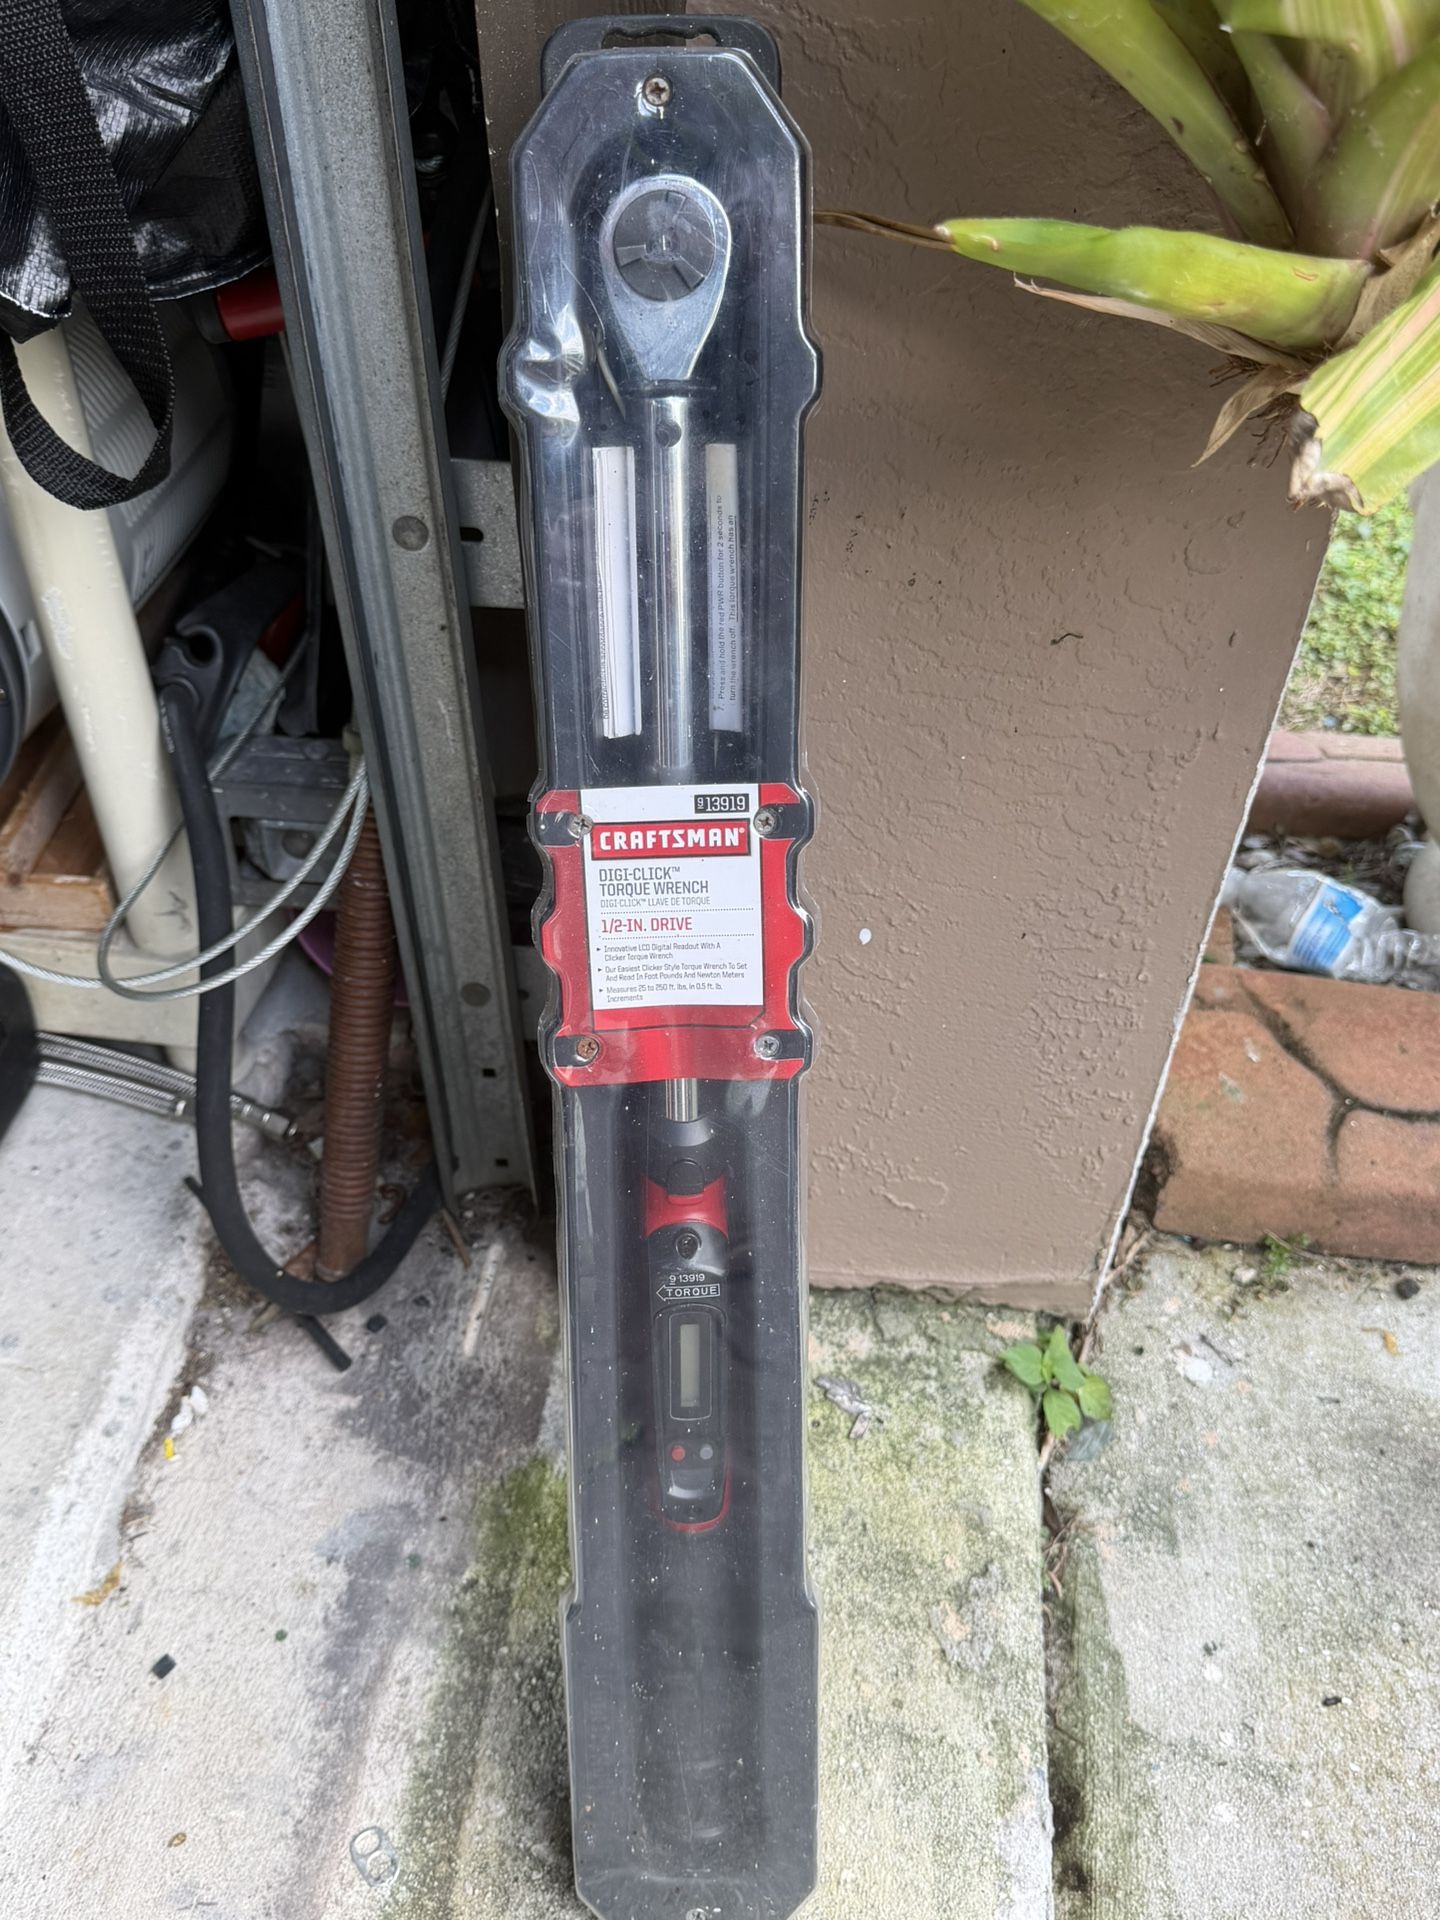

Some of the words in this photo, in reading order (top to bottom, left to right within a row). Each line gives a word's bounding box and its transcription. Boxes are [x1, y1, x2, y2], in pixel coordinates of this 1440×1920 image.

[716, 495, 722, 503] to
[728, 515, 734, 525] an
[716, 549, 724, 560] for
[716, 562, 724, 588] button
[600, 827, 739, 850] CRAFTSMAN
[599, 882, 650, 897] TORQUE
[654, 880, 709, 895] WRENCH
[648, 898, 669, 906] LLAVE
[671, 897, 680, 906] DE
[682, 896, 710, 906] TORQUE
[601, 918, 647, 934] 1/2-IN.
[650, 916, 693, 931] DRIVE
[604, 945, 637, 953] Innovative
[652, 943, 671, 952] Digital
[700, 942, 715, 950] With
[604, 954, 626, 962] Clicker
[627, 953, 648, 961] Torque
[650, 952, 673, 960] Wrench
[605, 966, 616, 974] Our
[617, 965, 640, 973] Easiest
[642, 964, 663, 972] Clicker
[664, 963, 680, 972] Style
[681, 963, 701, 971] Torque
[703, 962, 727, 970] Wrench
[728, 962, 736, 970] To
[606, 974, 618, 982] And
[636, 973, 643, 981] In
[644, 972, 658, 980] Foot
[607, 986, 637, 994] Measures
[689, 982, 695, 990] in
[696, 982, 706, 990] 0.5
[607, 994, 643, 1003] Increments
[666, 1286, 717, 1297] TORQUE
